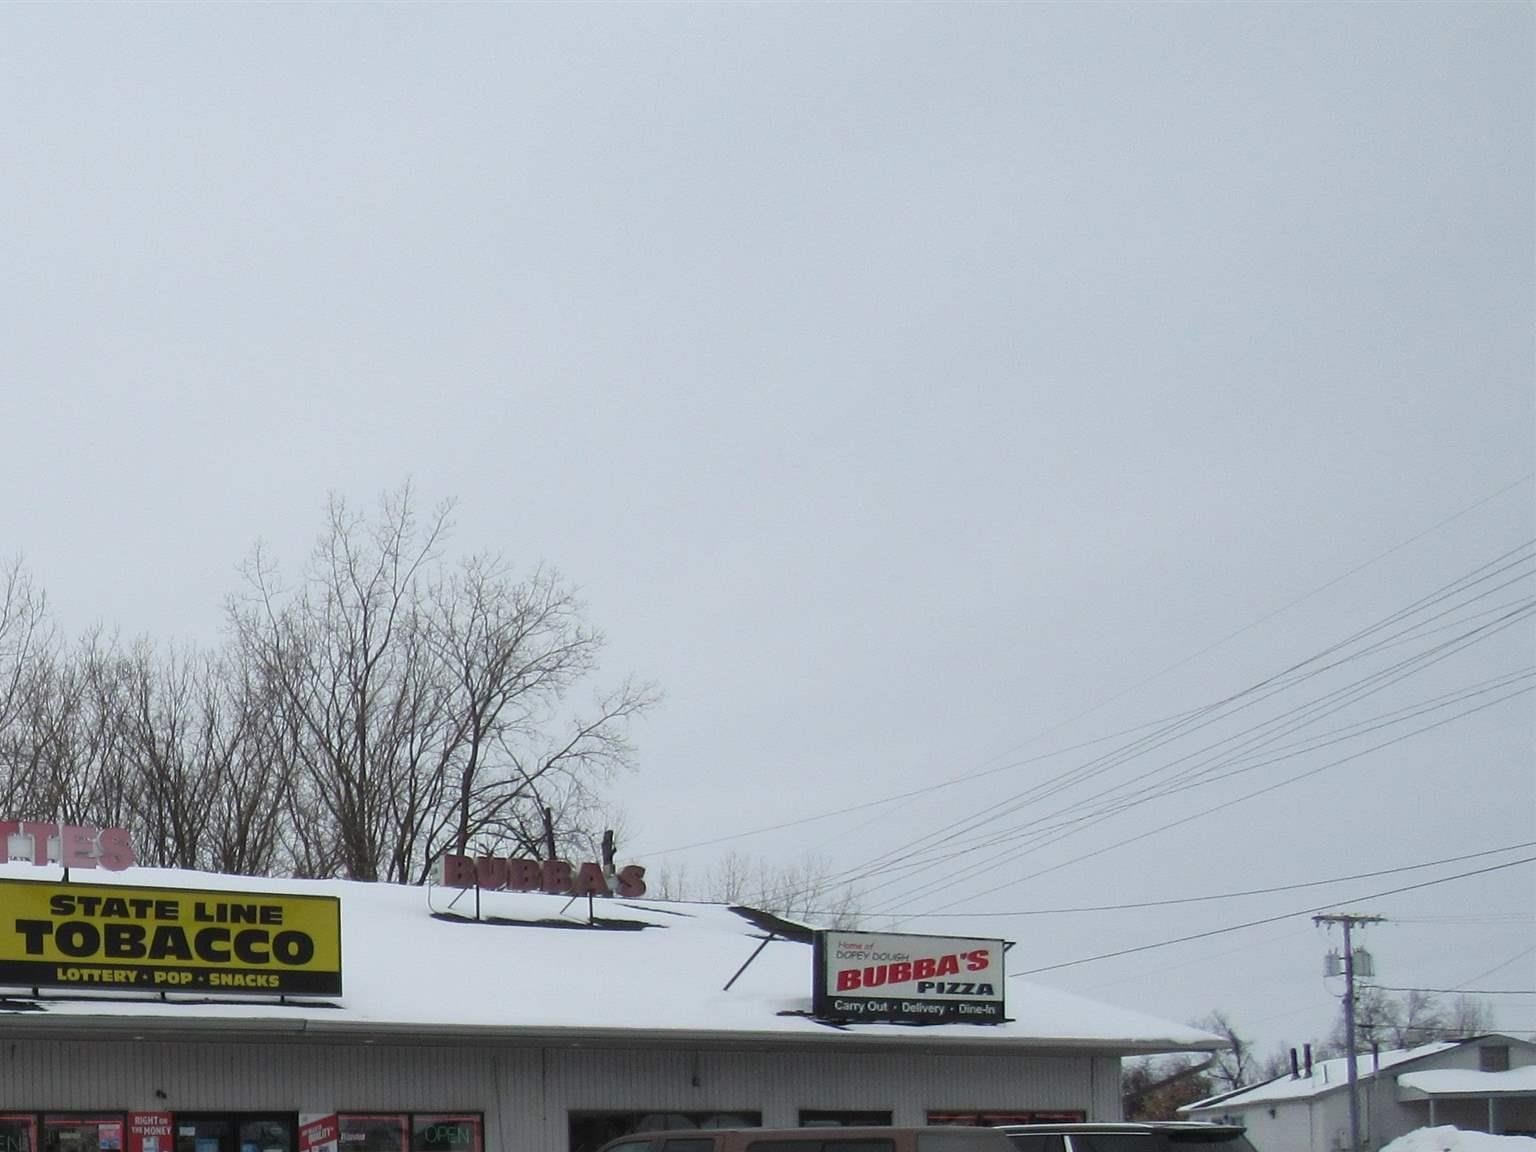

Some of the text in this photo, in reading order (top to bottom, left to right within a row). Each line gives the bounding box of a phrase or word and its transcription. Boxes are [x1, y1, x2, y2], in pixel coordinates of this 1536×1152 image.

[50, 895, 283, 925] STATE LINE
[15, 919, 314, 965] TOBACCO
[838, 941, 875, 951] Home of
[836, 950, 910, 962] DOPEY DOUGH
[57, 967, 280, 988] LOTTERY POP SNACKS
[836, 949, 989, 992] BUBBA'S
[917, 981, 995, 995] PIZZA
[834, 1000, 996, 1015] Carry Out Delivery Dine-In
[134, 1116, 158, 1125] RIGHT
[144, 1126, 172, 1136] MONEY
[425, 1126, 470, 1144] OPEN
